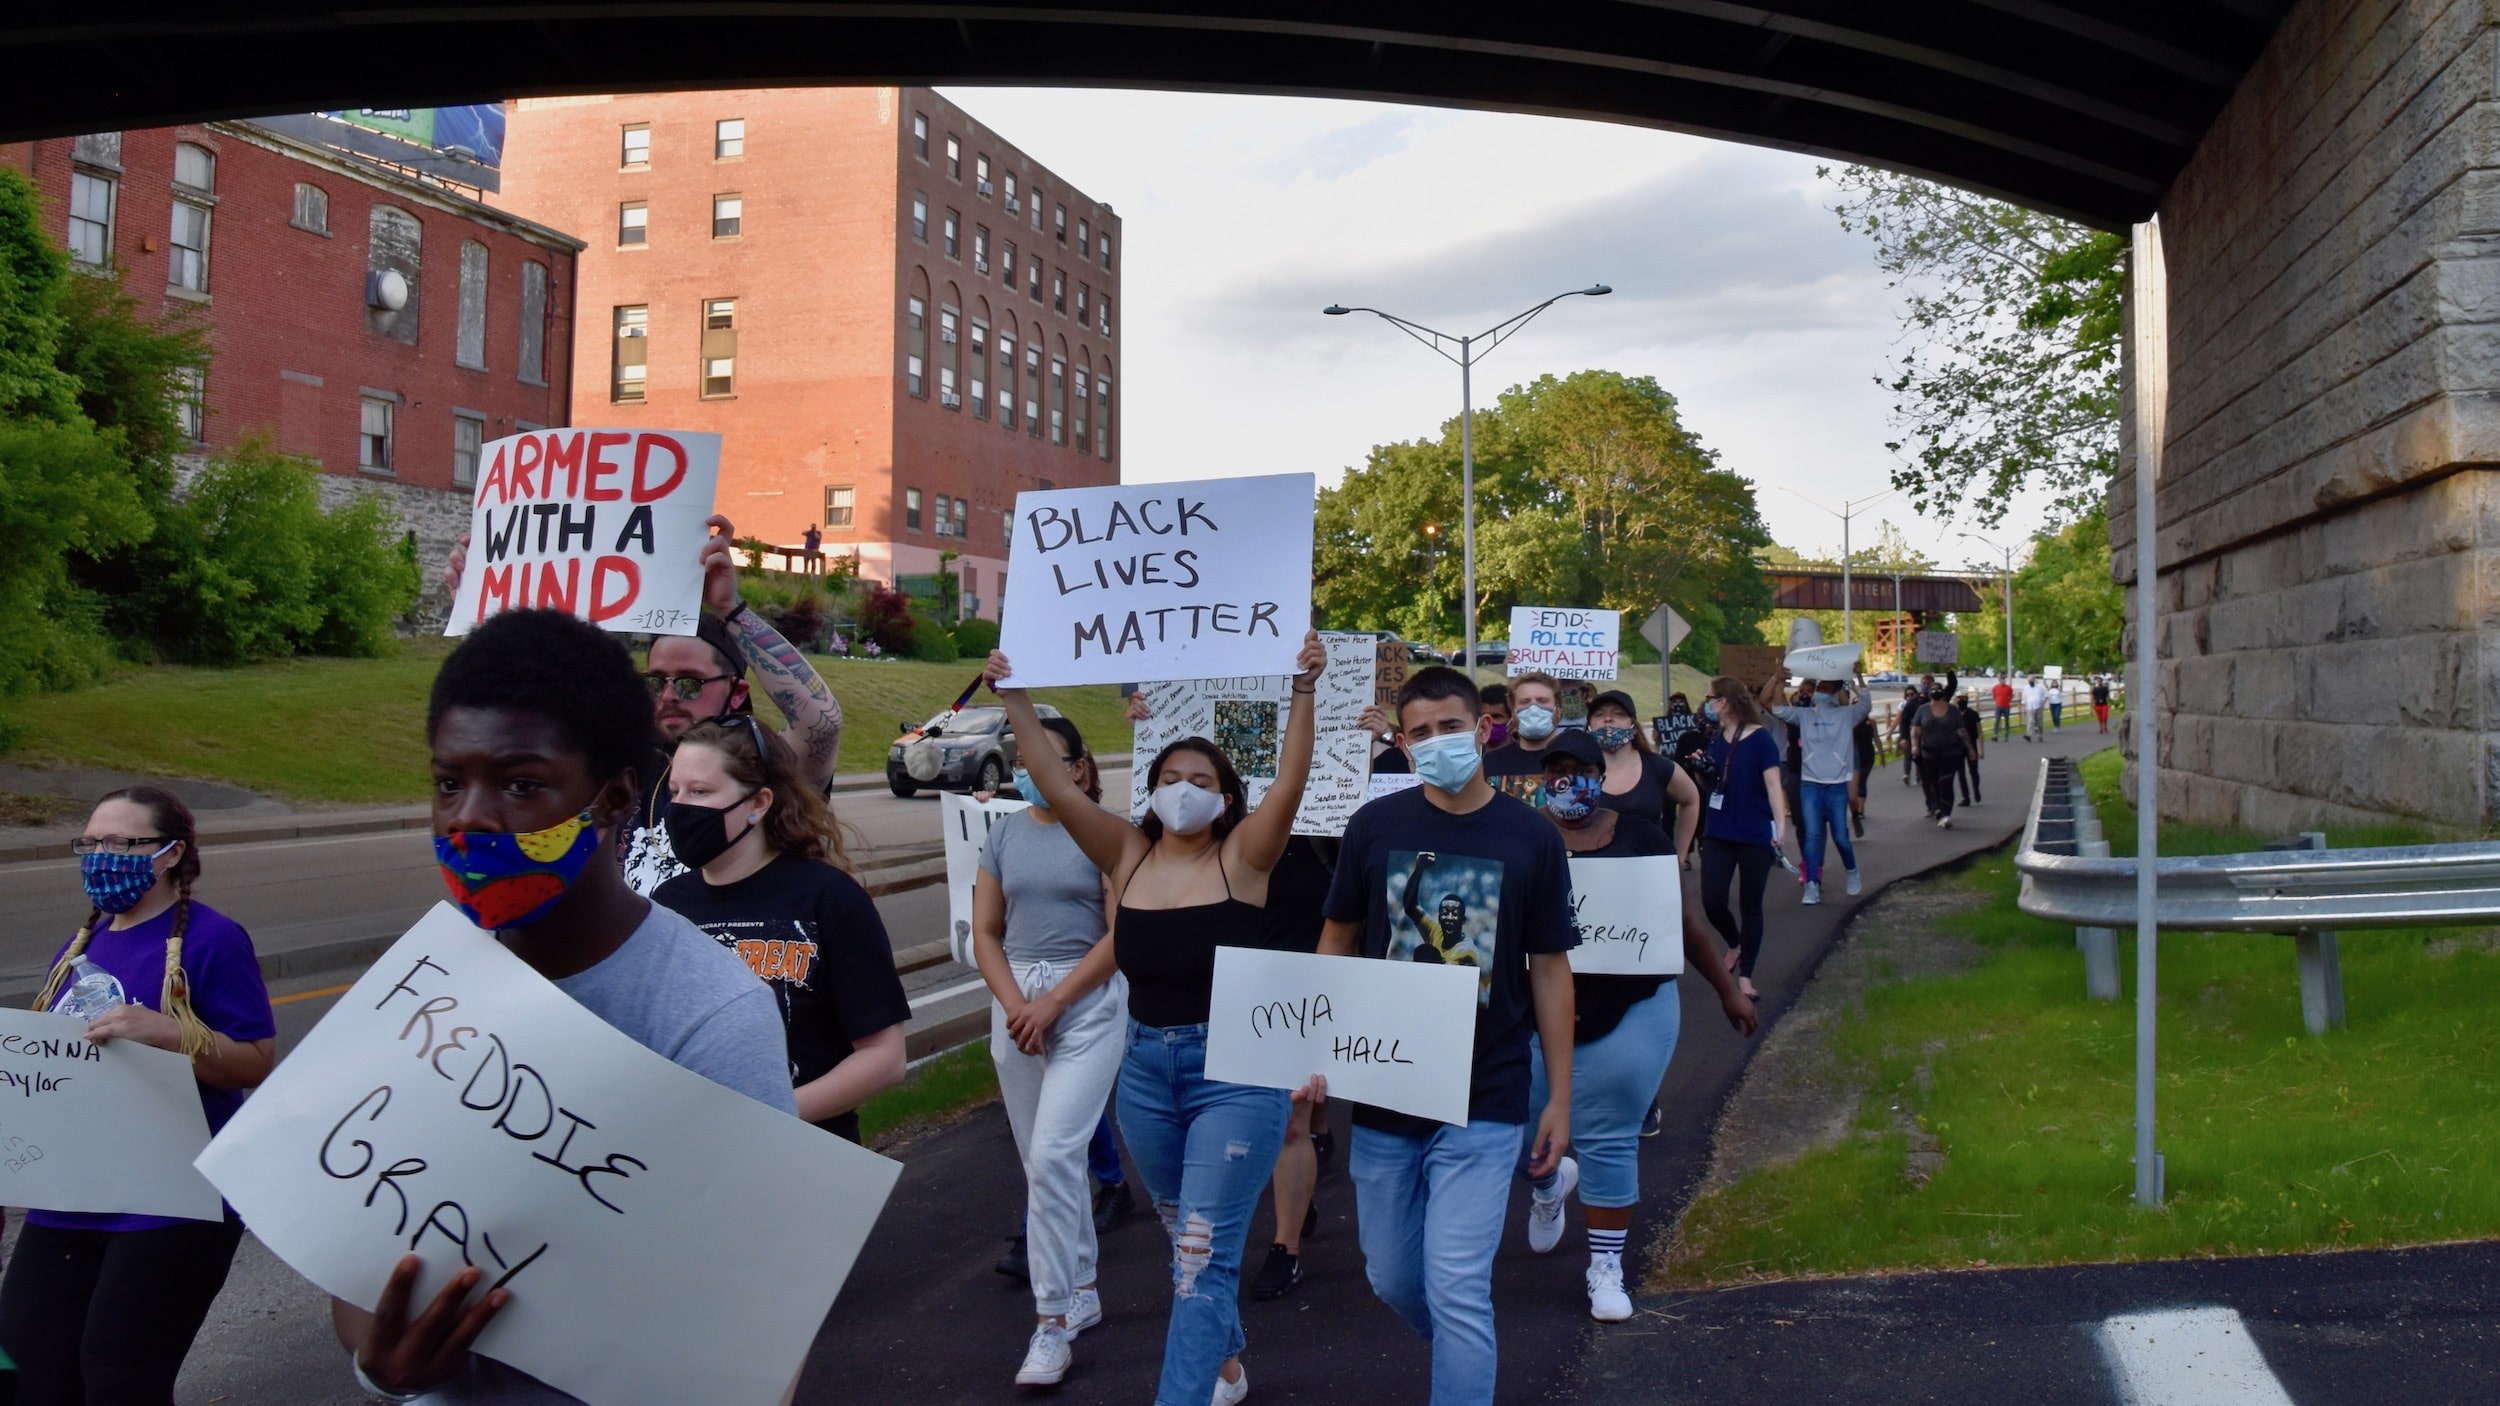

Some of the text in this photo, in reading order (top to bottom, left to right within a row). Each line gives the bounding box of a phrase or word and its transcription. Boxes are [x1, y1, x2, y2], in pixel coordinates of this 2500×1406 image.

[477, 432, 688, 508] ARMED
[486, 503, 655, 563] WITH A
[1027, 498, 1219, 554] BLACK
[477, 555, 641, 624] MIND
[1052, 550, 1199, 596] LIVES
[1823, 581, 1894, 597] PROVIDENC
[1074, 602, 1280, 660] MATTER
[1333, 644, 1340, 652] 5
[1531, 630, 1606, 647] POLICE
[1509, 649, 1618, 667] BRUTALITY
[1657, 714, 1697, 731] BLACK
[1661, 730, 1687, 743] LIV
[736, 939, 817, 987] TREAT
[1252, 994, 1333, 1038] MYA
[1332, 1034, 1413, 1064] HALL
[374, 955, 648, 1215] FREDDIE
[319, 1085, 548, 1293] GRAY
